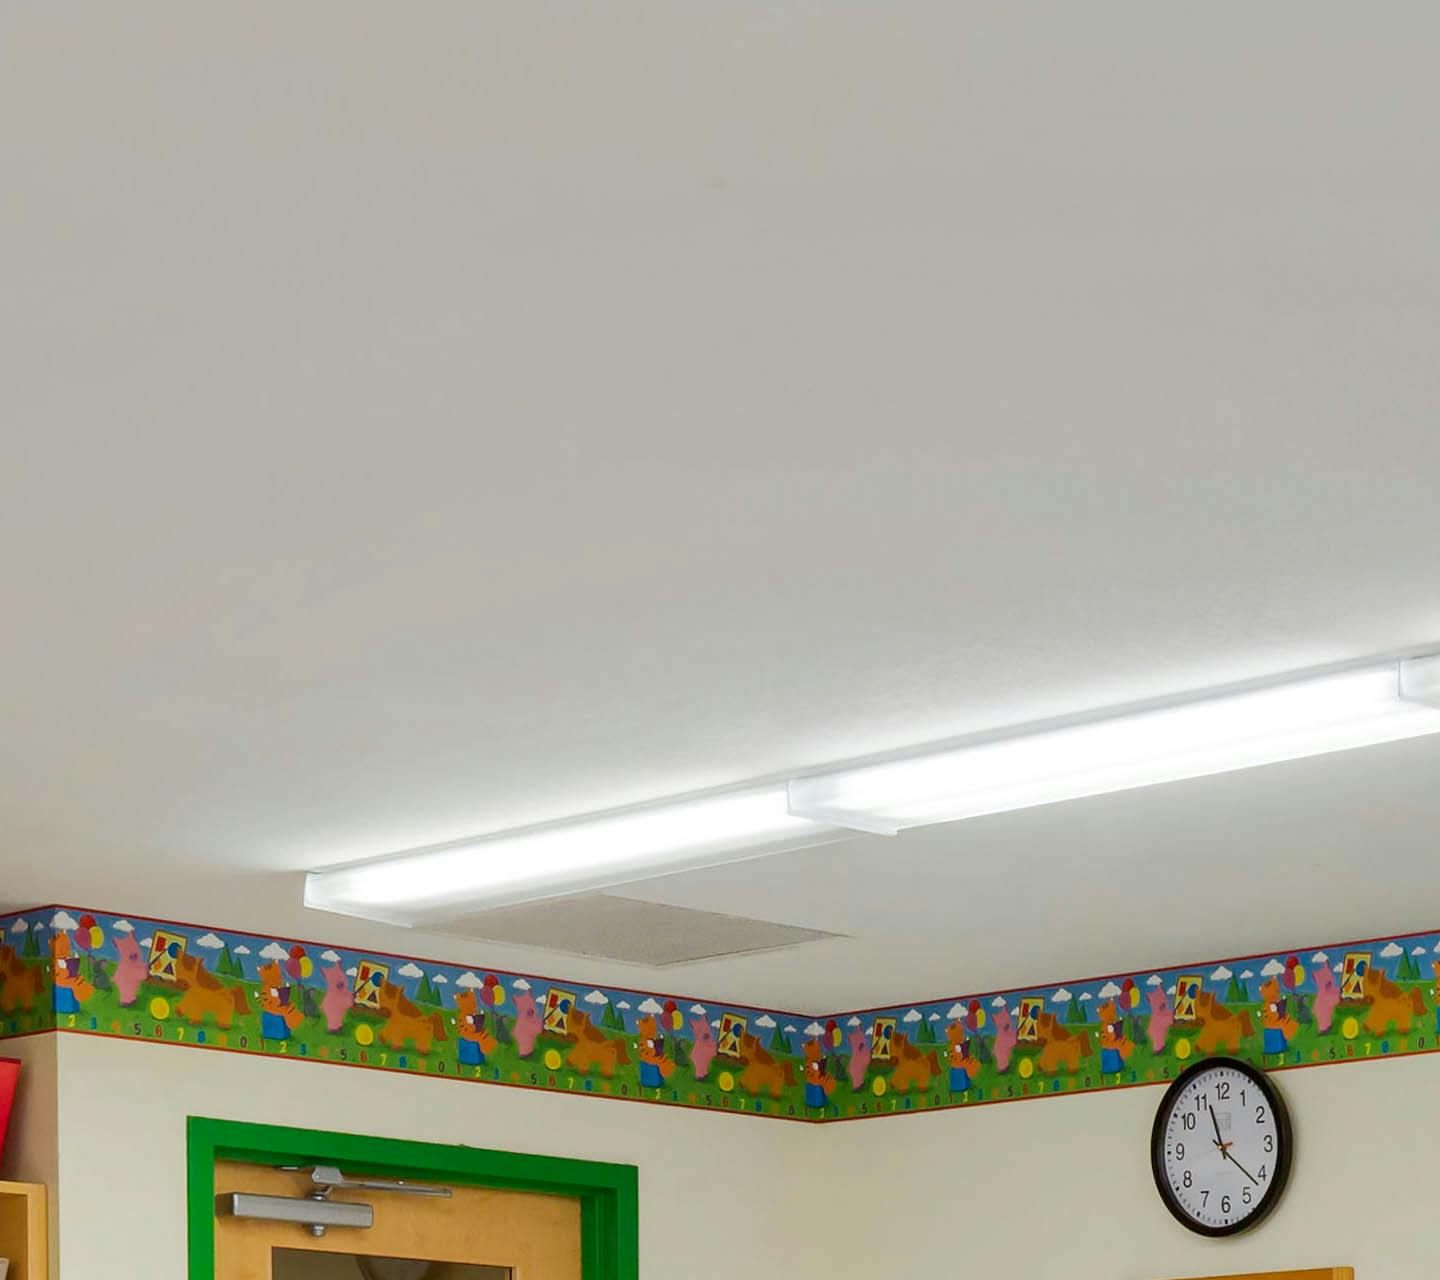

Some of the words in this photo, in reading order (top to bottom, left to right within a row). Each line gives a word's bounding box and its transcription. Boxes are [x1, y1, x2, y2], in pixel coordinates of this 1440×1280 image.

[1215, 1082, 1230, 1100] 12
[1240, 1090, 1246, 1106] 1
[1195, 1094, 1207, 1110] 11
[1182, 1113, 1196, 1130] 10
[1256, 1106, 1265, 1123] 2
[1176, 1143, 1184, 1160] 9
[1264, 1135, 1273, 1152] 3
[1184, 1171, 1192, 1188] 8
[1258, 1165, 1266, 1180] 4
[1201, 1191, 1209, 1207] 7
[1243, 1187, 1251, 1203] 5
[1221, 1196, 1230, 1213] 6
